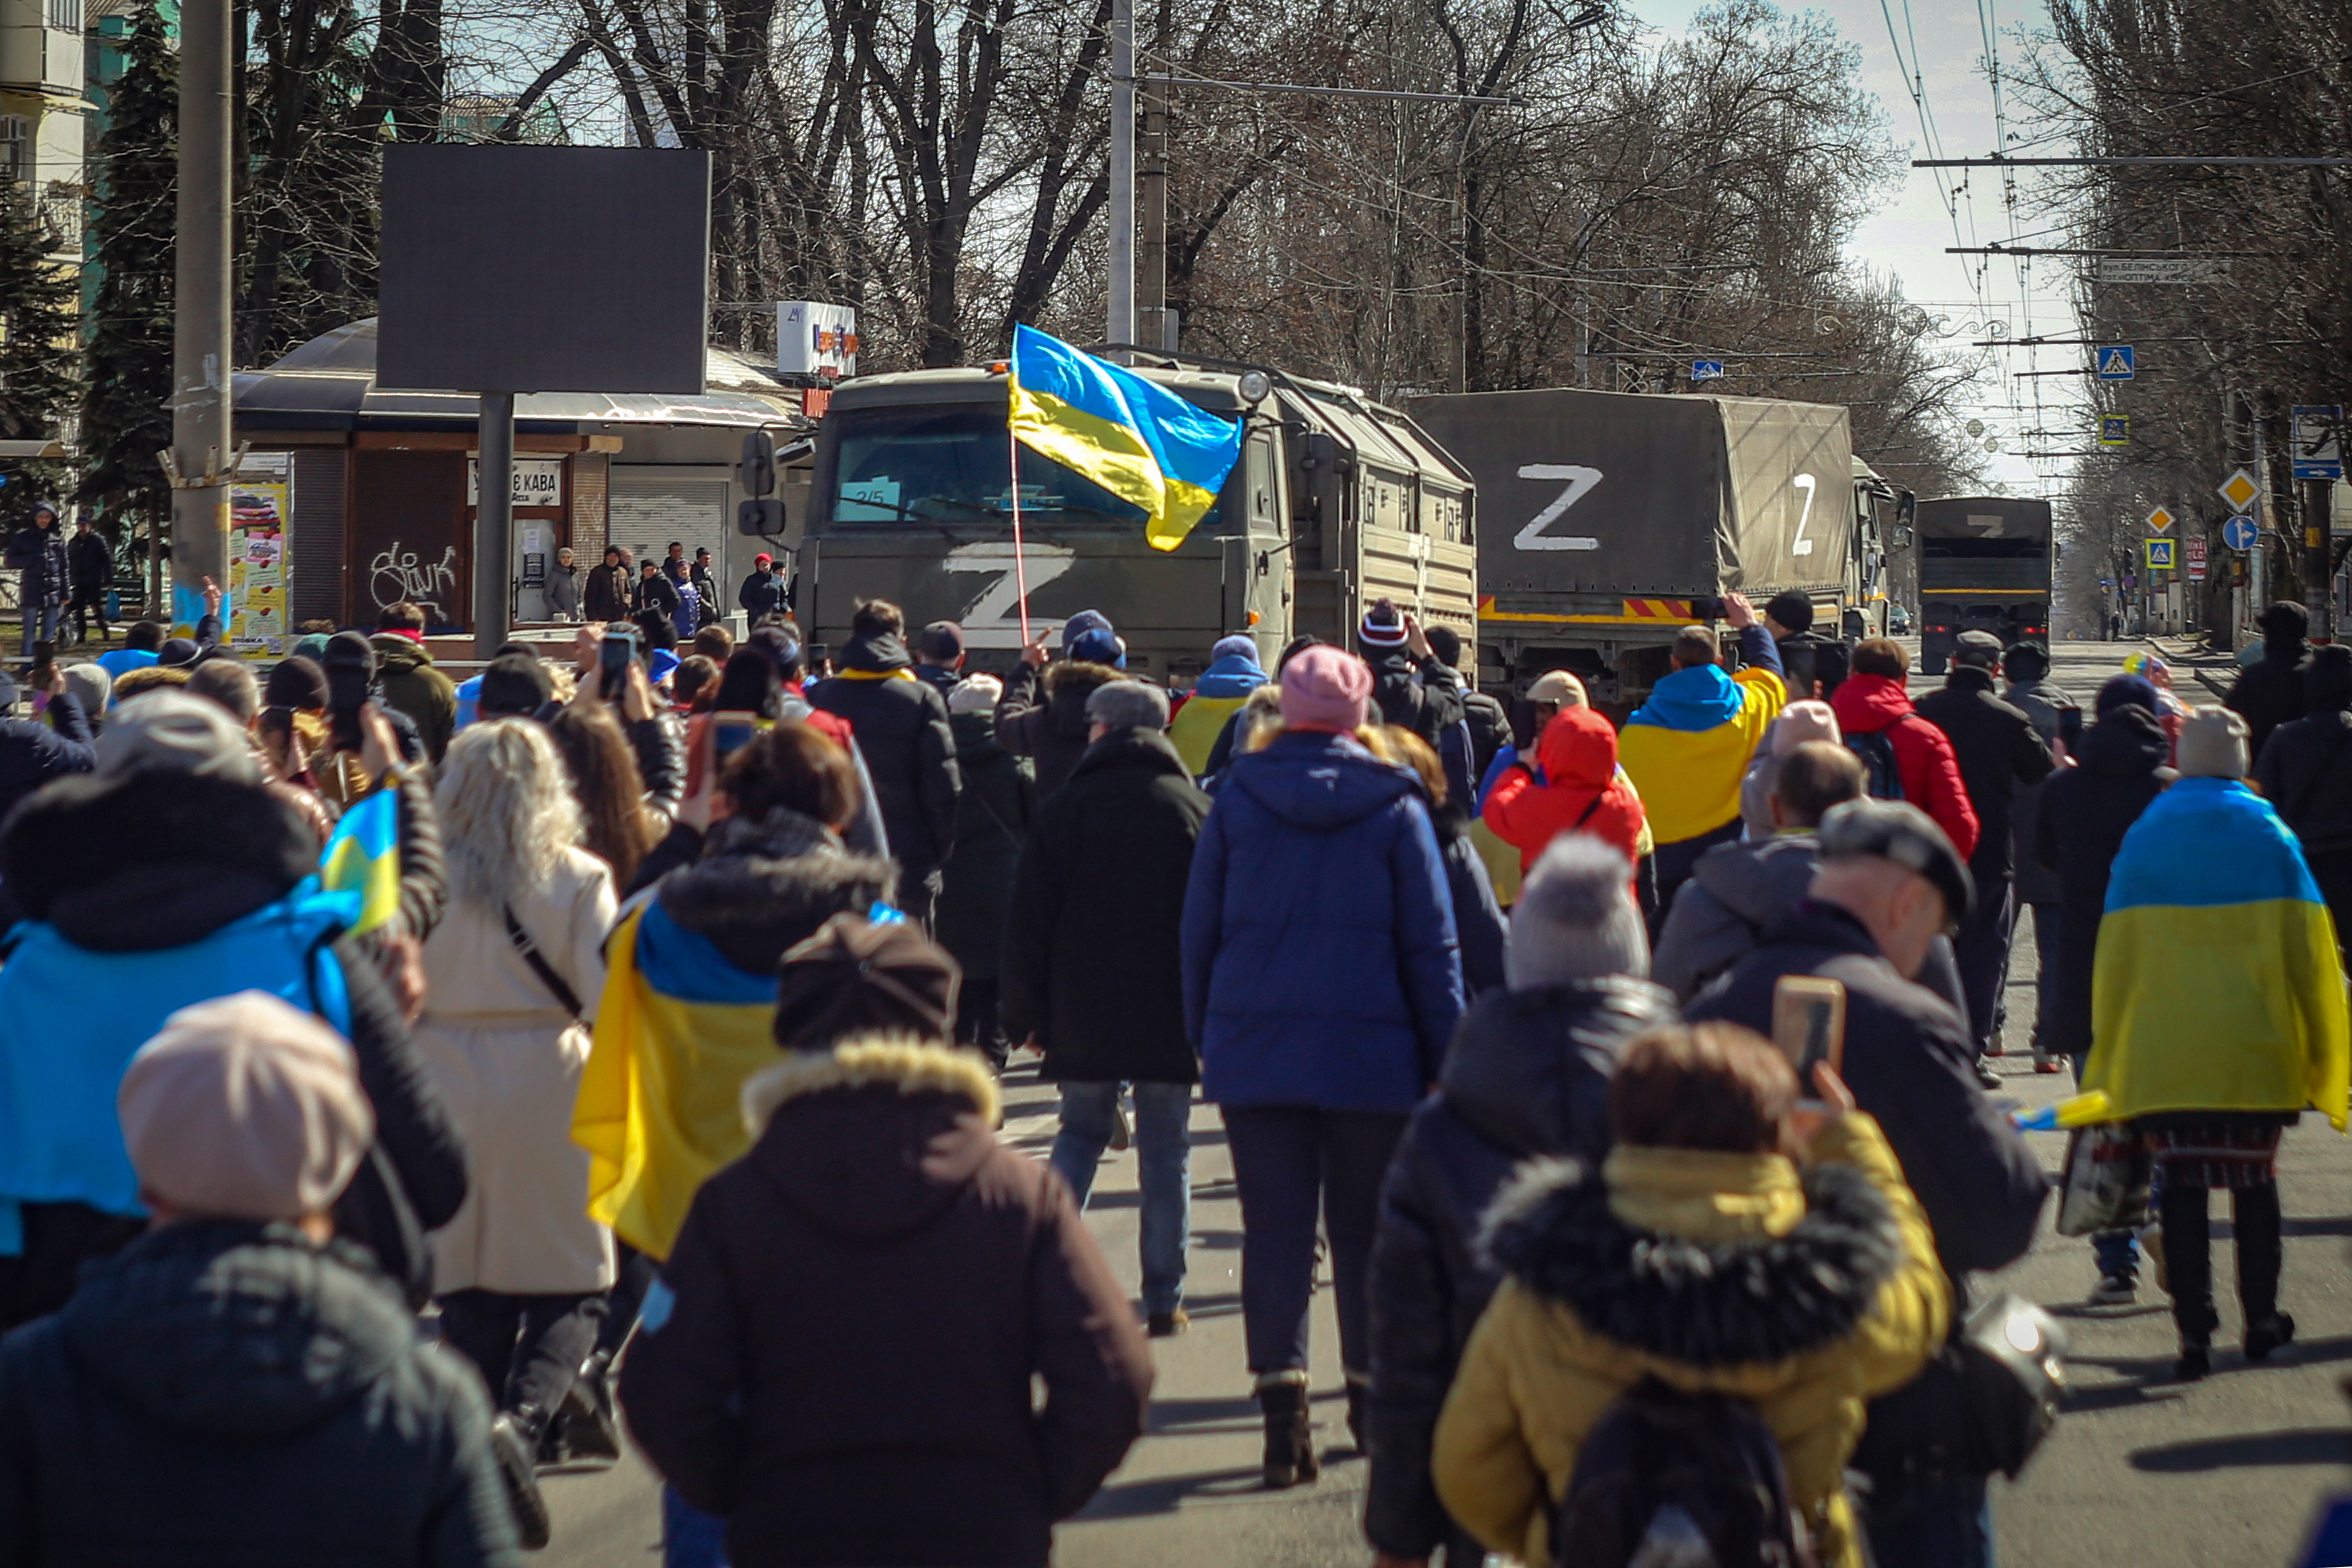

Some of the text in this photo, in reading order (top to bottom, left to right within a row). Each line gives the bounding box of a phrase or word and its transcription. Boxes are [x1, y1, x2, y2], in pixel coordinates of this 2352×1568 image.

[524, 474, 555, 491] КАВА
[856, 490, 884, 505] 2/5
[1513, 463, 1603, 550] Z
[943, 541, 1076, 649] Z
